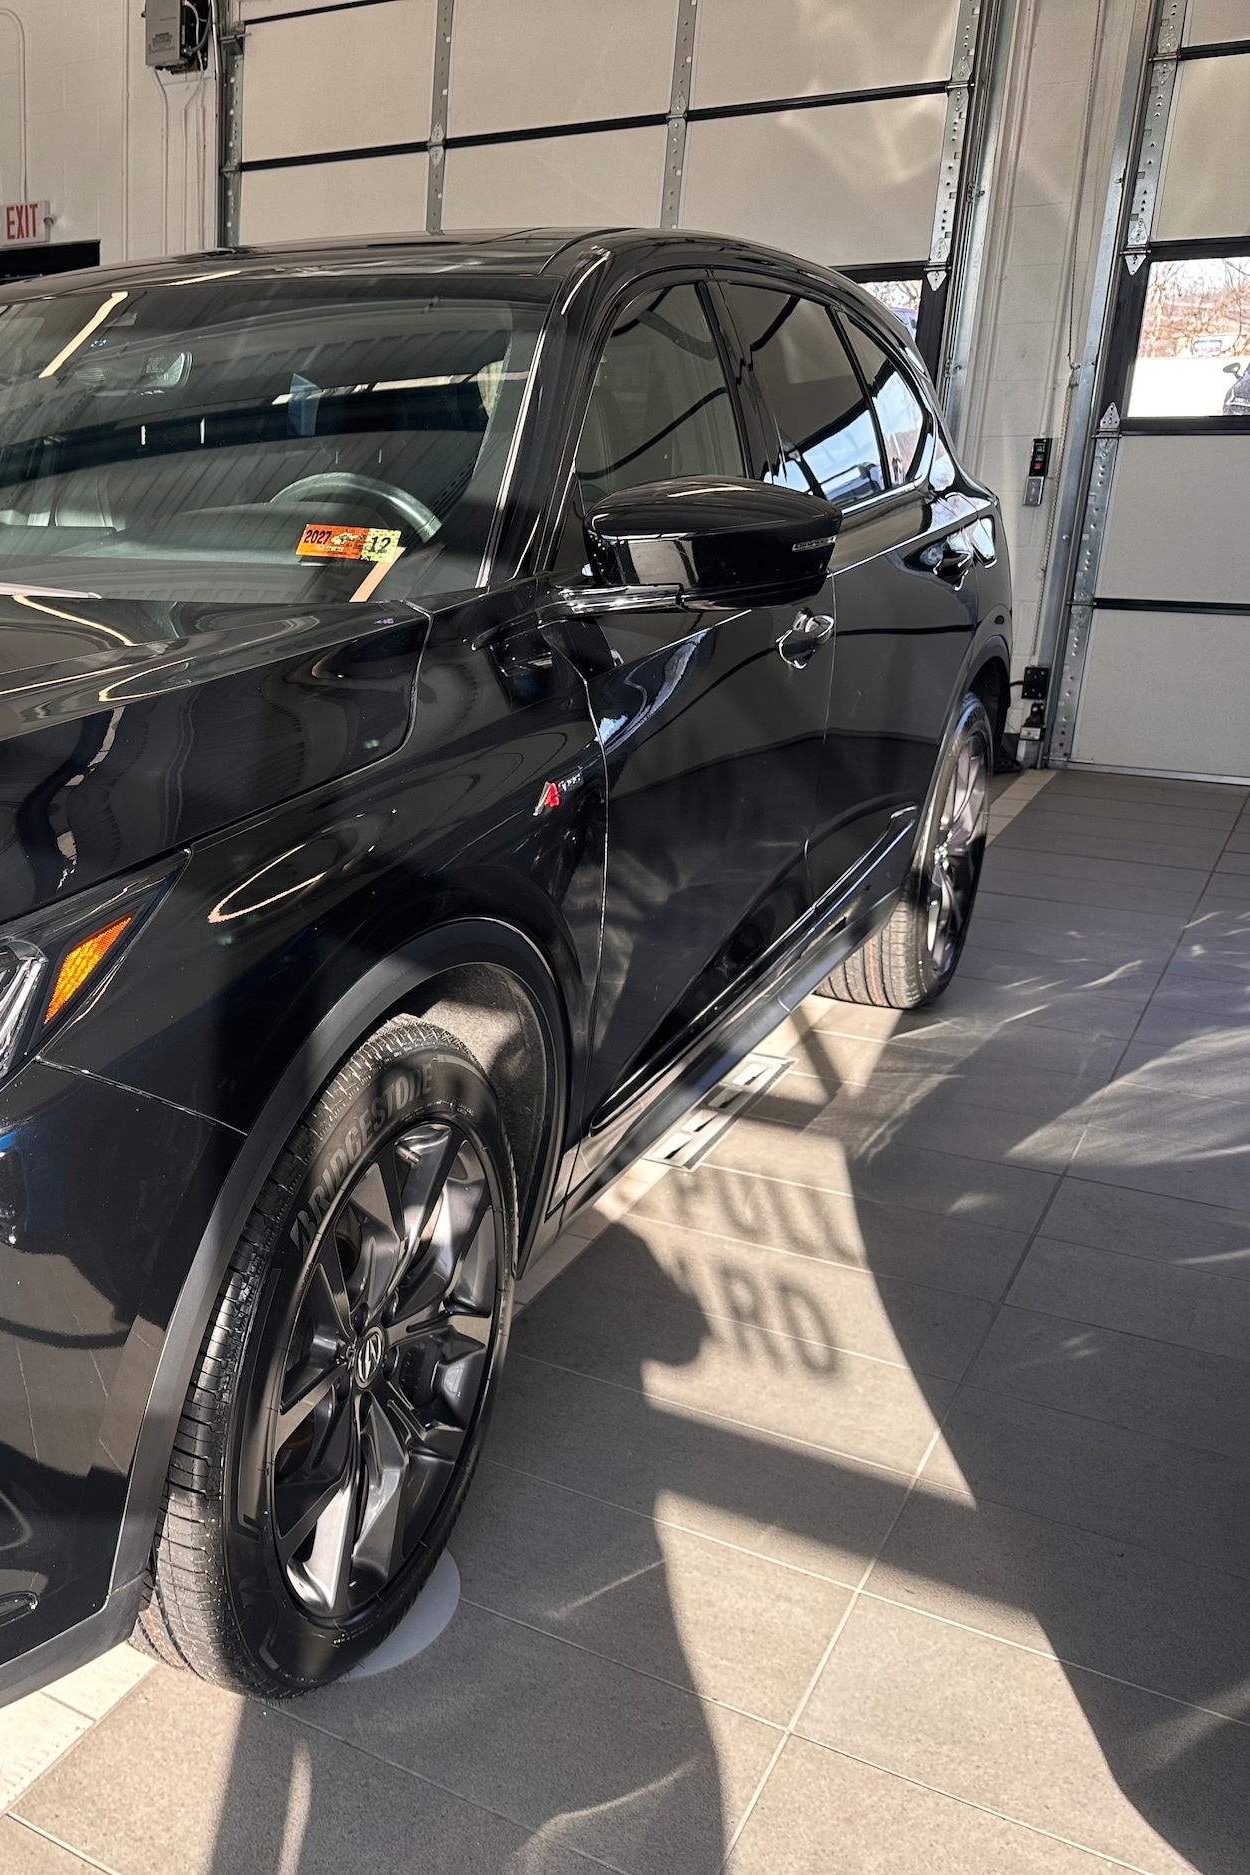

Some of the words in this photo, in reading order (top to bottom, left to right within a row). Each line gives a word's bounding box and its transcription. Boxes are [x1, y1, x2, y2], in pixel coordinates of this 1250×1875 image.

[5, 203, 38, 240] EXIT
[303, 529, 332, 545] 2027
[368, 536, 391, 553] 12
[290, 1062, 434, 1260] BRIDGESTONE
